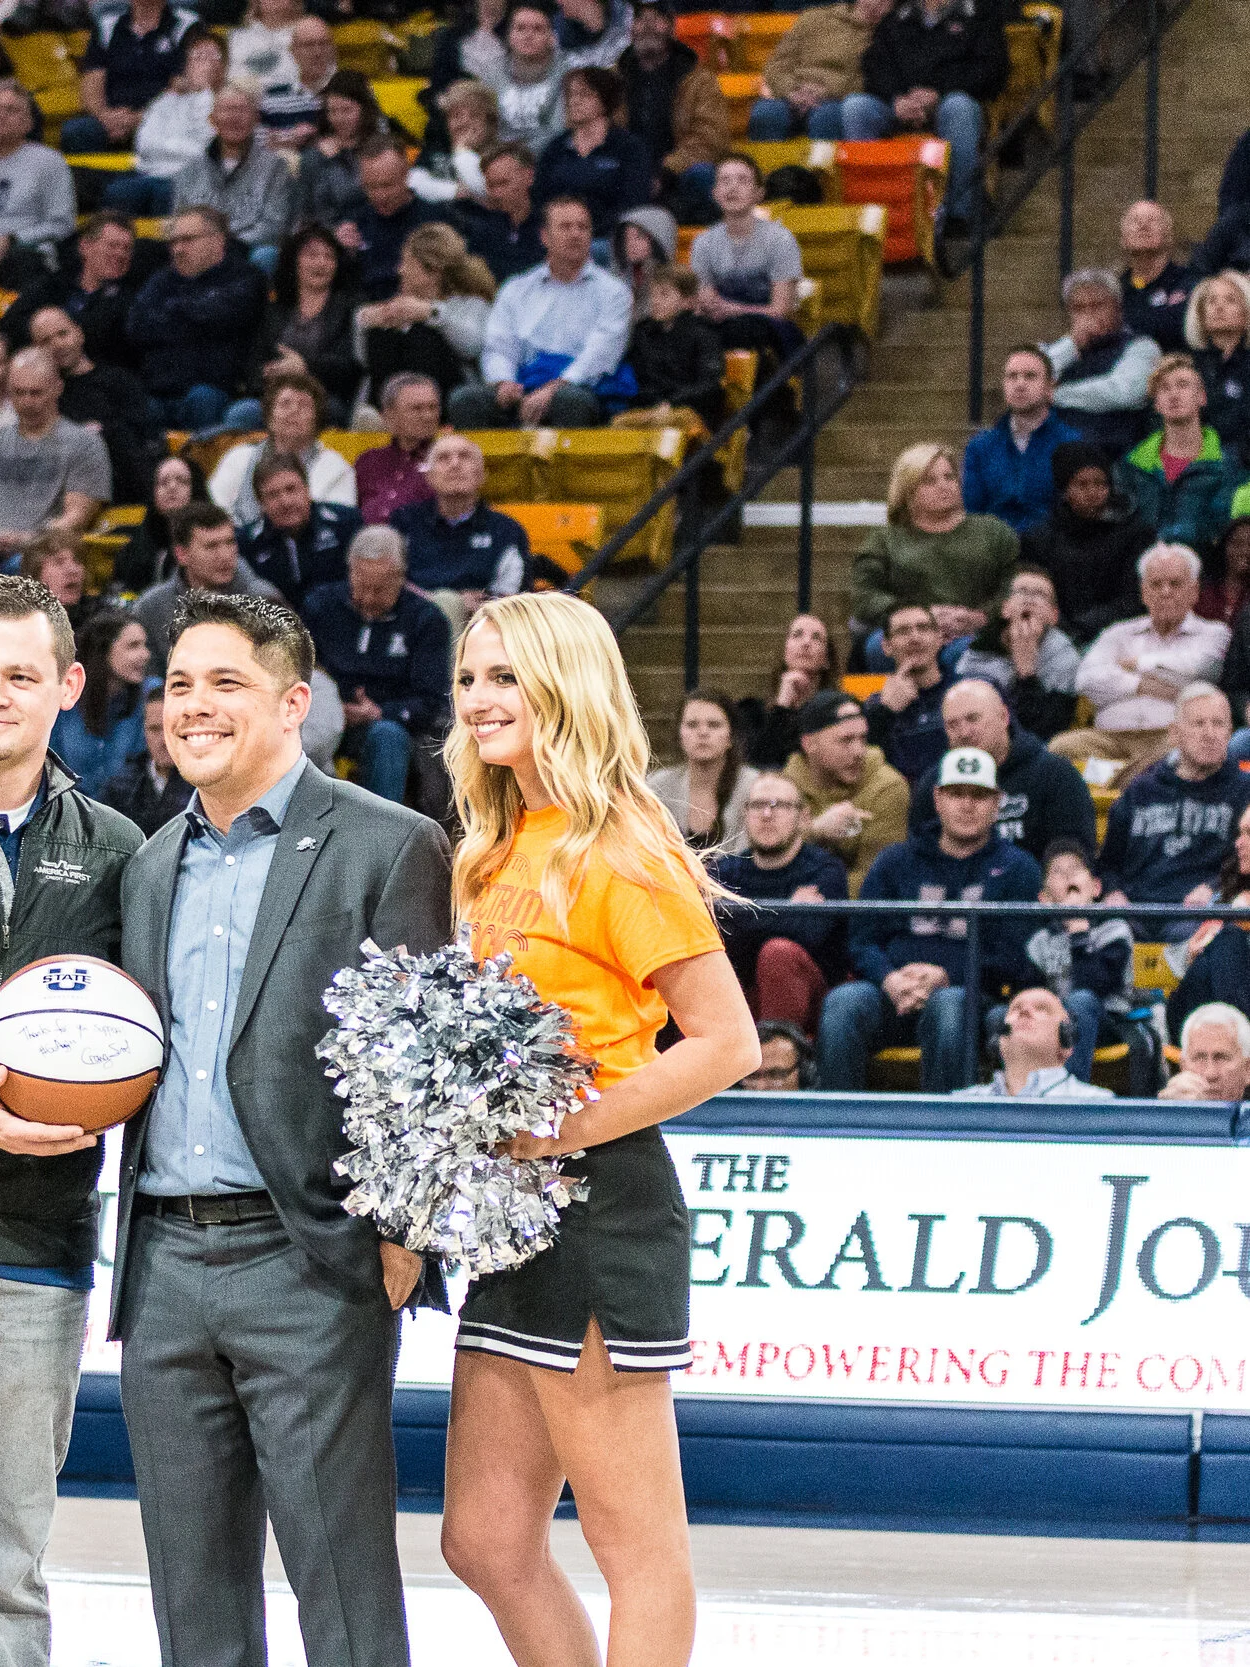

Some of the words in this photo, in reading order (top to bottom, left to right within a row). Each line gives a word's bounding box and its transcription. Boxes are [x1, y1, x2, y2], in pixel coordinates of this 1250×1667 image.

[33, 866, 70, 877] AMERICA
[69, 871, 92, 882] FIRST
[42, 974, 92, 985] STATE
[692, 1153, 791, 1193] THE
[688, 1207, 1054, 1295] ERALD
[685, 1340, 1010, 1388] EMPOWERING
[1028, 1350, 1122, 1388] THE
